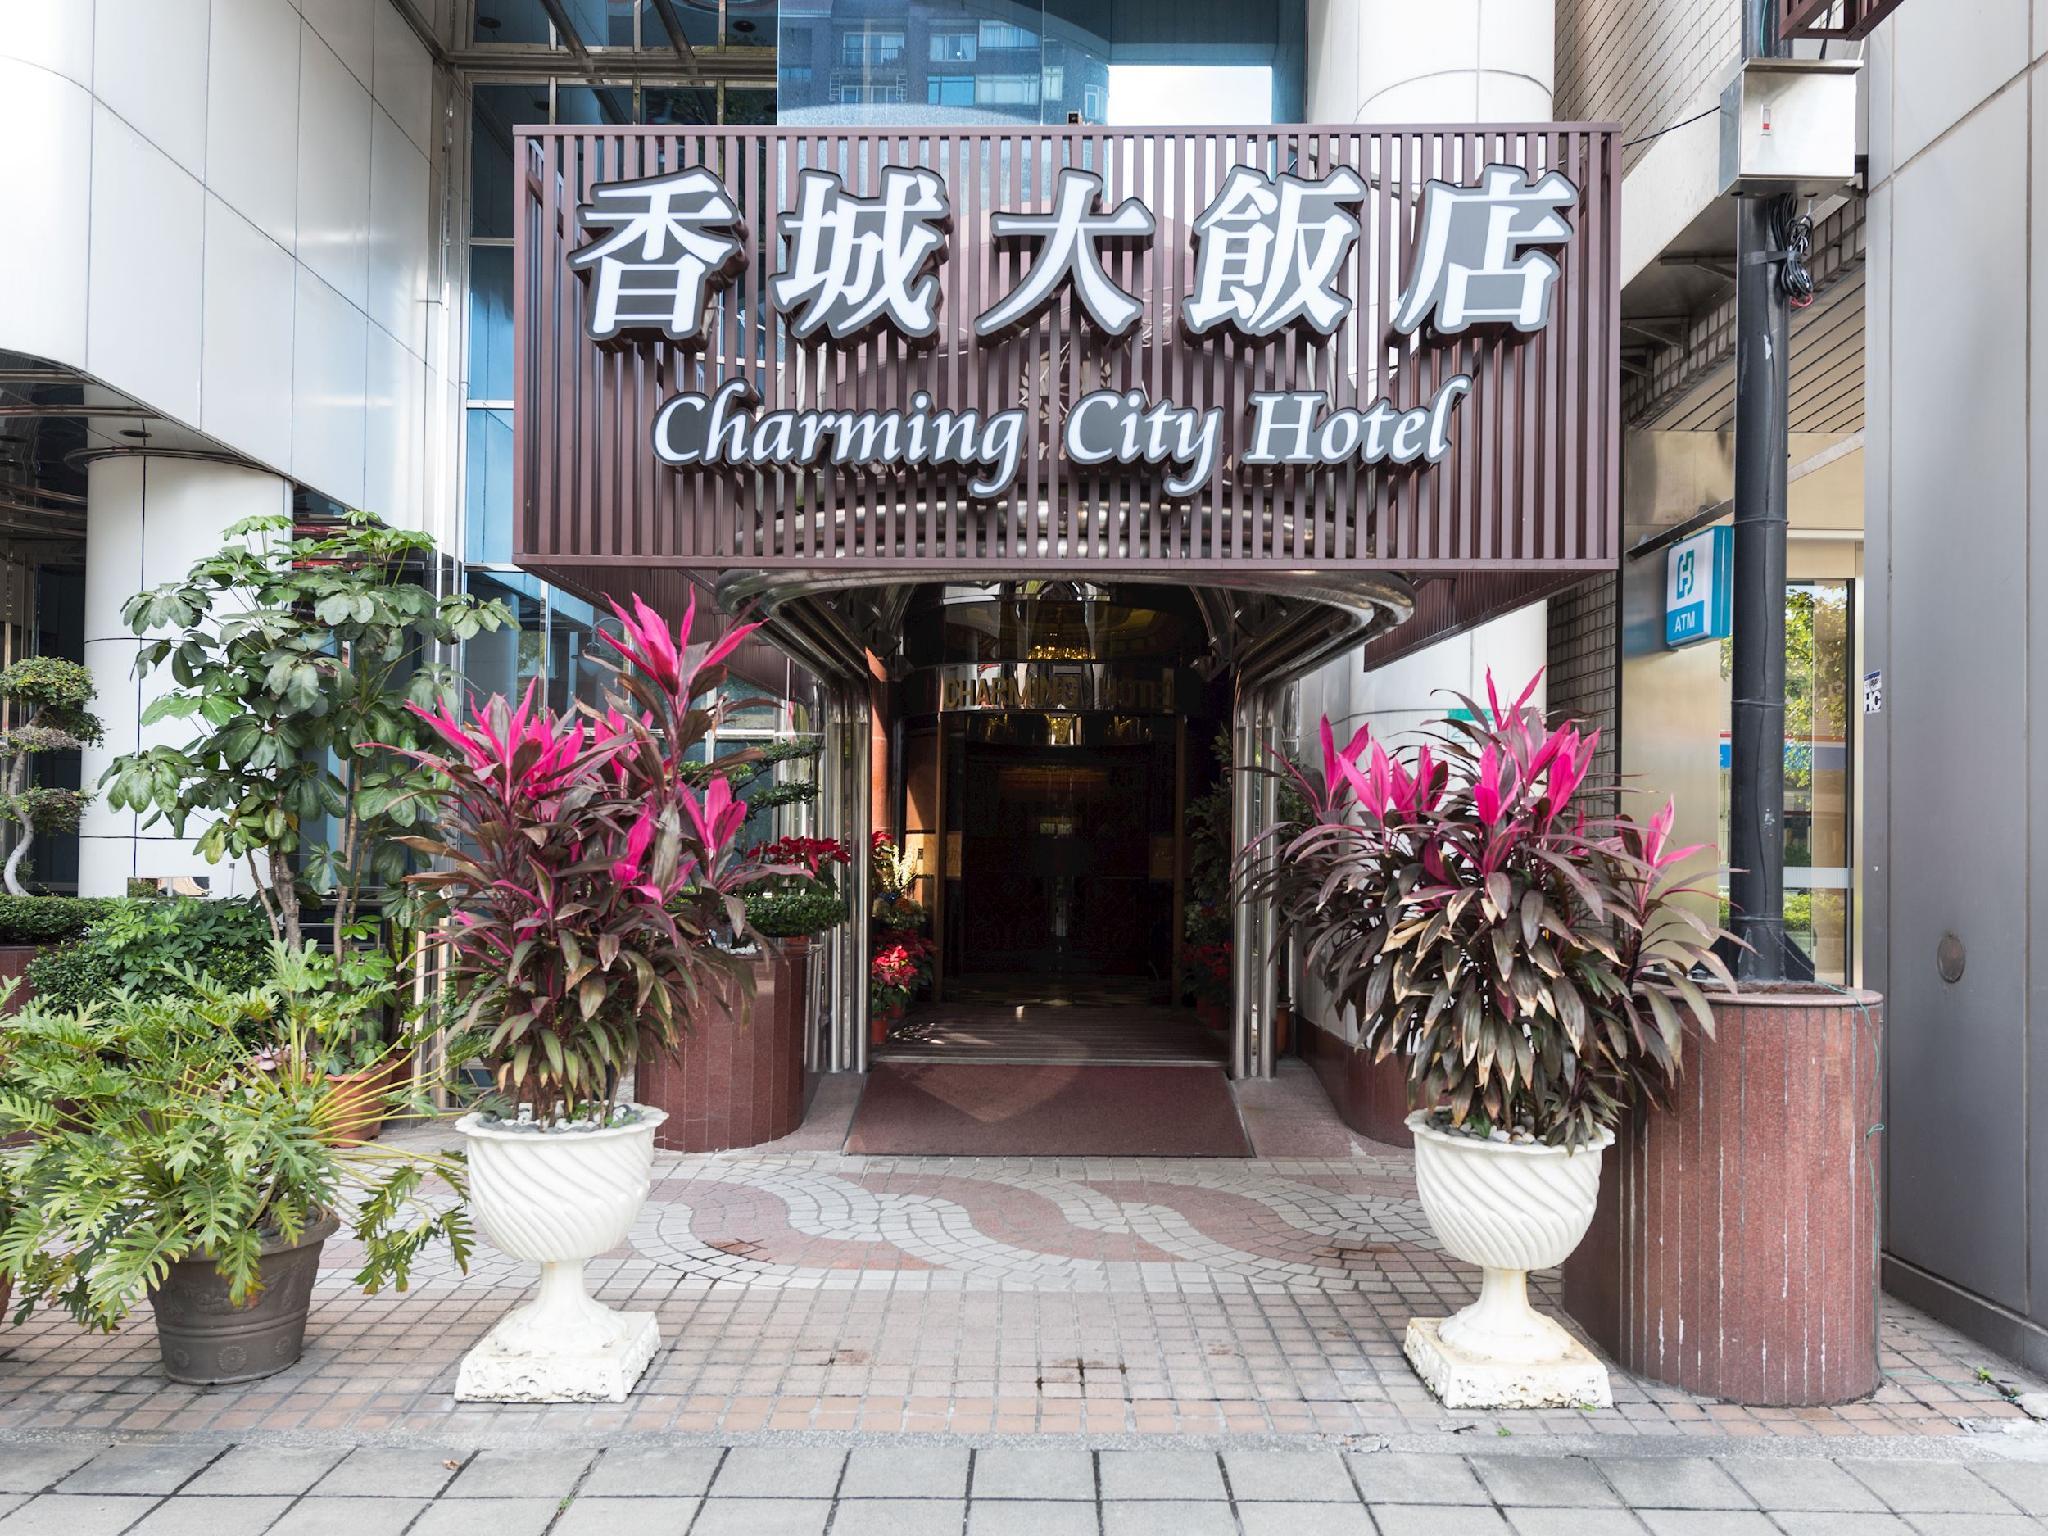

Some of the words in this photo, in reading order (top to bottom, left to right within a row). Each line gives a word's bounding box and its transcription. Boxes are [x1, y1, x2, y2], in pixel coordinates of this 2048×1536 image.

[572, 170, 1573, 335] 香城大飯店
[653, 377, 1024, 494] Charming
[1067, 393, 1221, 494] City
[1247, 378, 1468, 460] Hotel
[1674, 610, 1696, 632] ATM
[943, 675, 1081, 708] CHARMING
